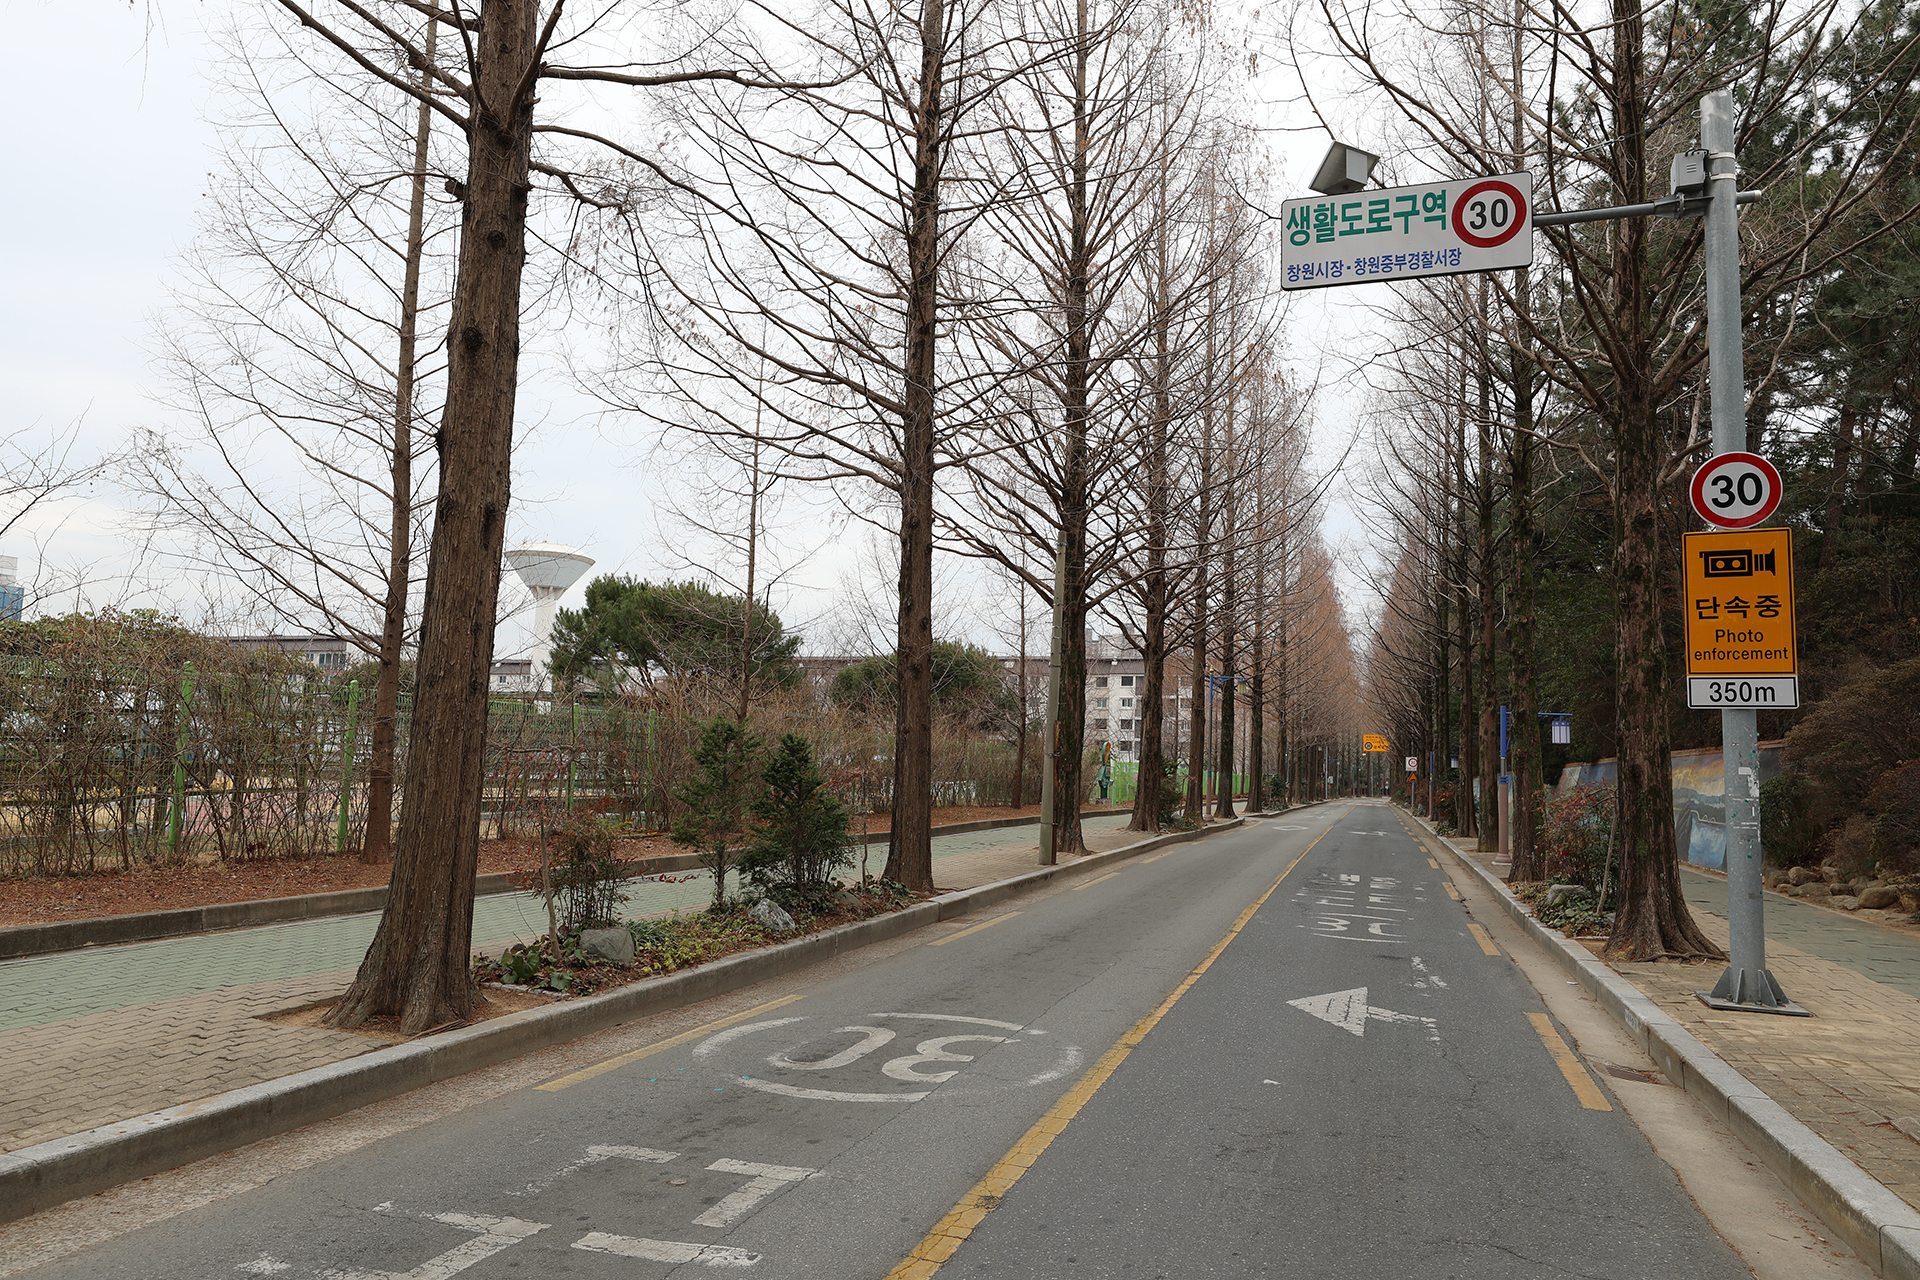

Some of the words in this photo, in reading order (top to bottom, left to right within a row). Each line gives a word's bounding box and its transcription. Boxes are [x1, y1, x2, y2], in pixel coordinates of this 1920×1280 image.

[1286, 189, 1447, 246] 생활도로구역
[1469, 198, 1509, 230] 30
[1710, 472, 1763, 508] 30
[1695, 594, 1782, 620] 단속중
[1715, 629, 1764, 643] Photo
[1694, 647, 1788, 661] enforcement
[1709, 682, 1776, 702] 350m
